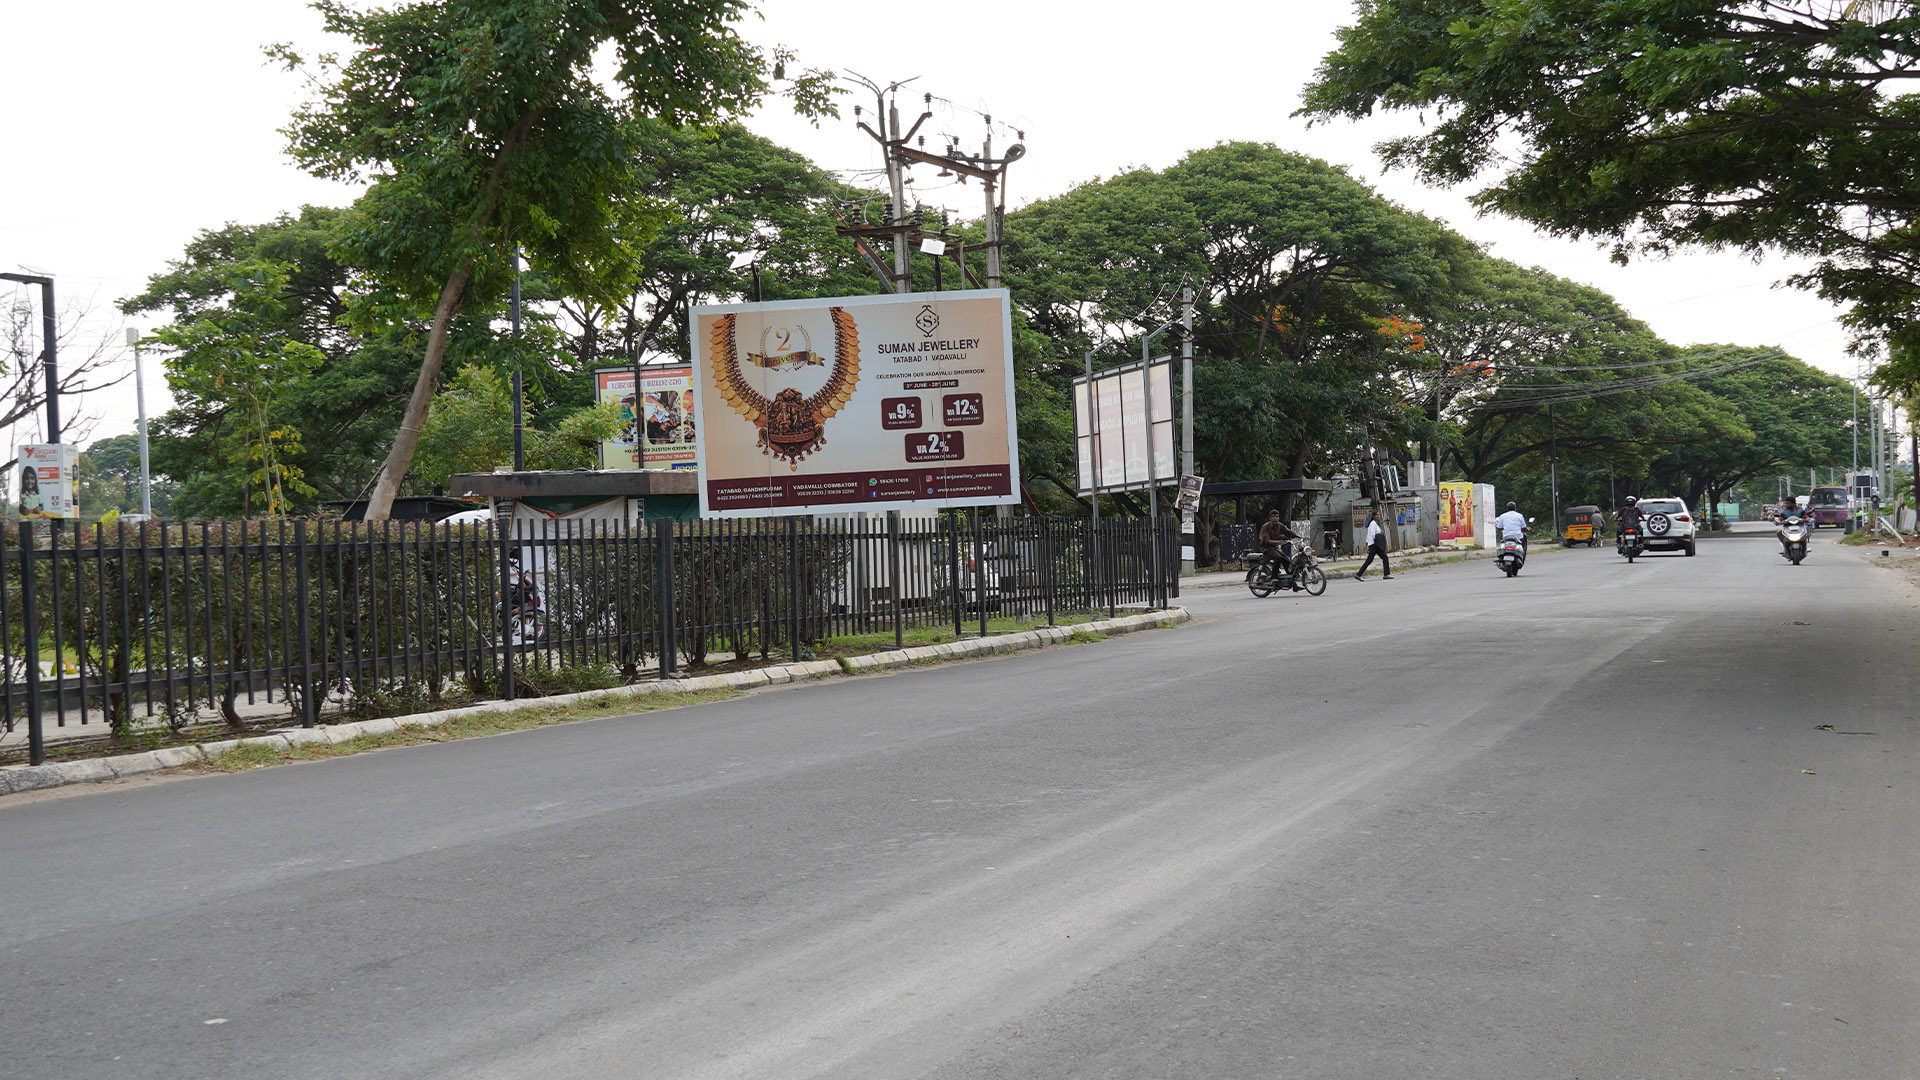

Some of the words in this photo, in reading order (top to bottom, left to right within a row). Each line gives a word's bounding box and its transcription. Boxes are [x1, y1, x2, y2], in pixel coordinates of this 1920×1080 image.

[878, 342, 915, 354] SUMAN
[918, 339, 980, 352] JEWELLERY
[893, 355, 922, 363] TATABAD
[931, 353, 967, 361] VADAVALLI
[888, 412, 896, 420] VA
[916, 445, 927, 454] VA
